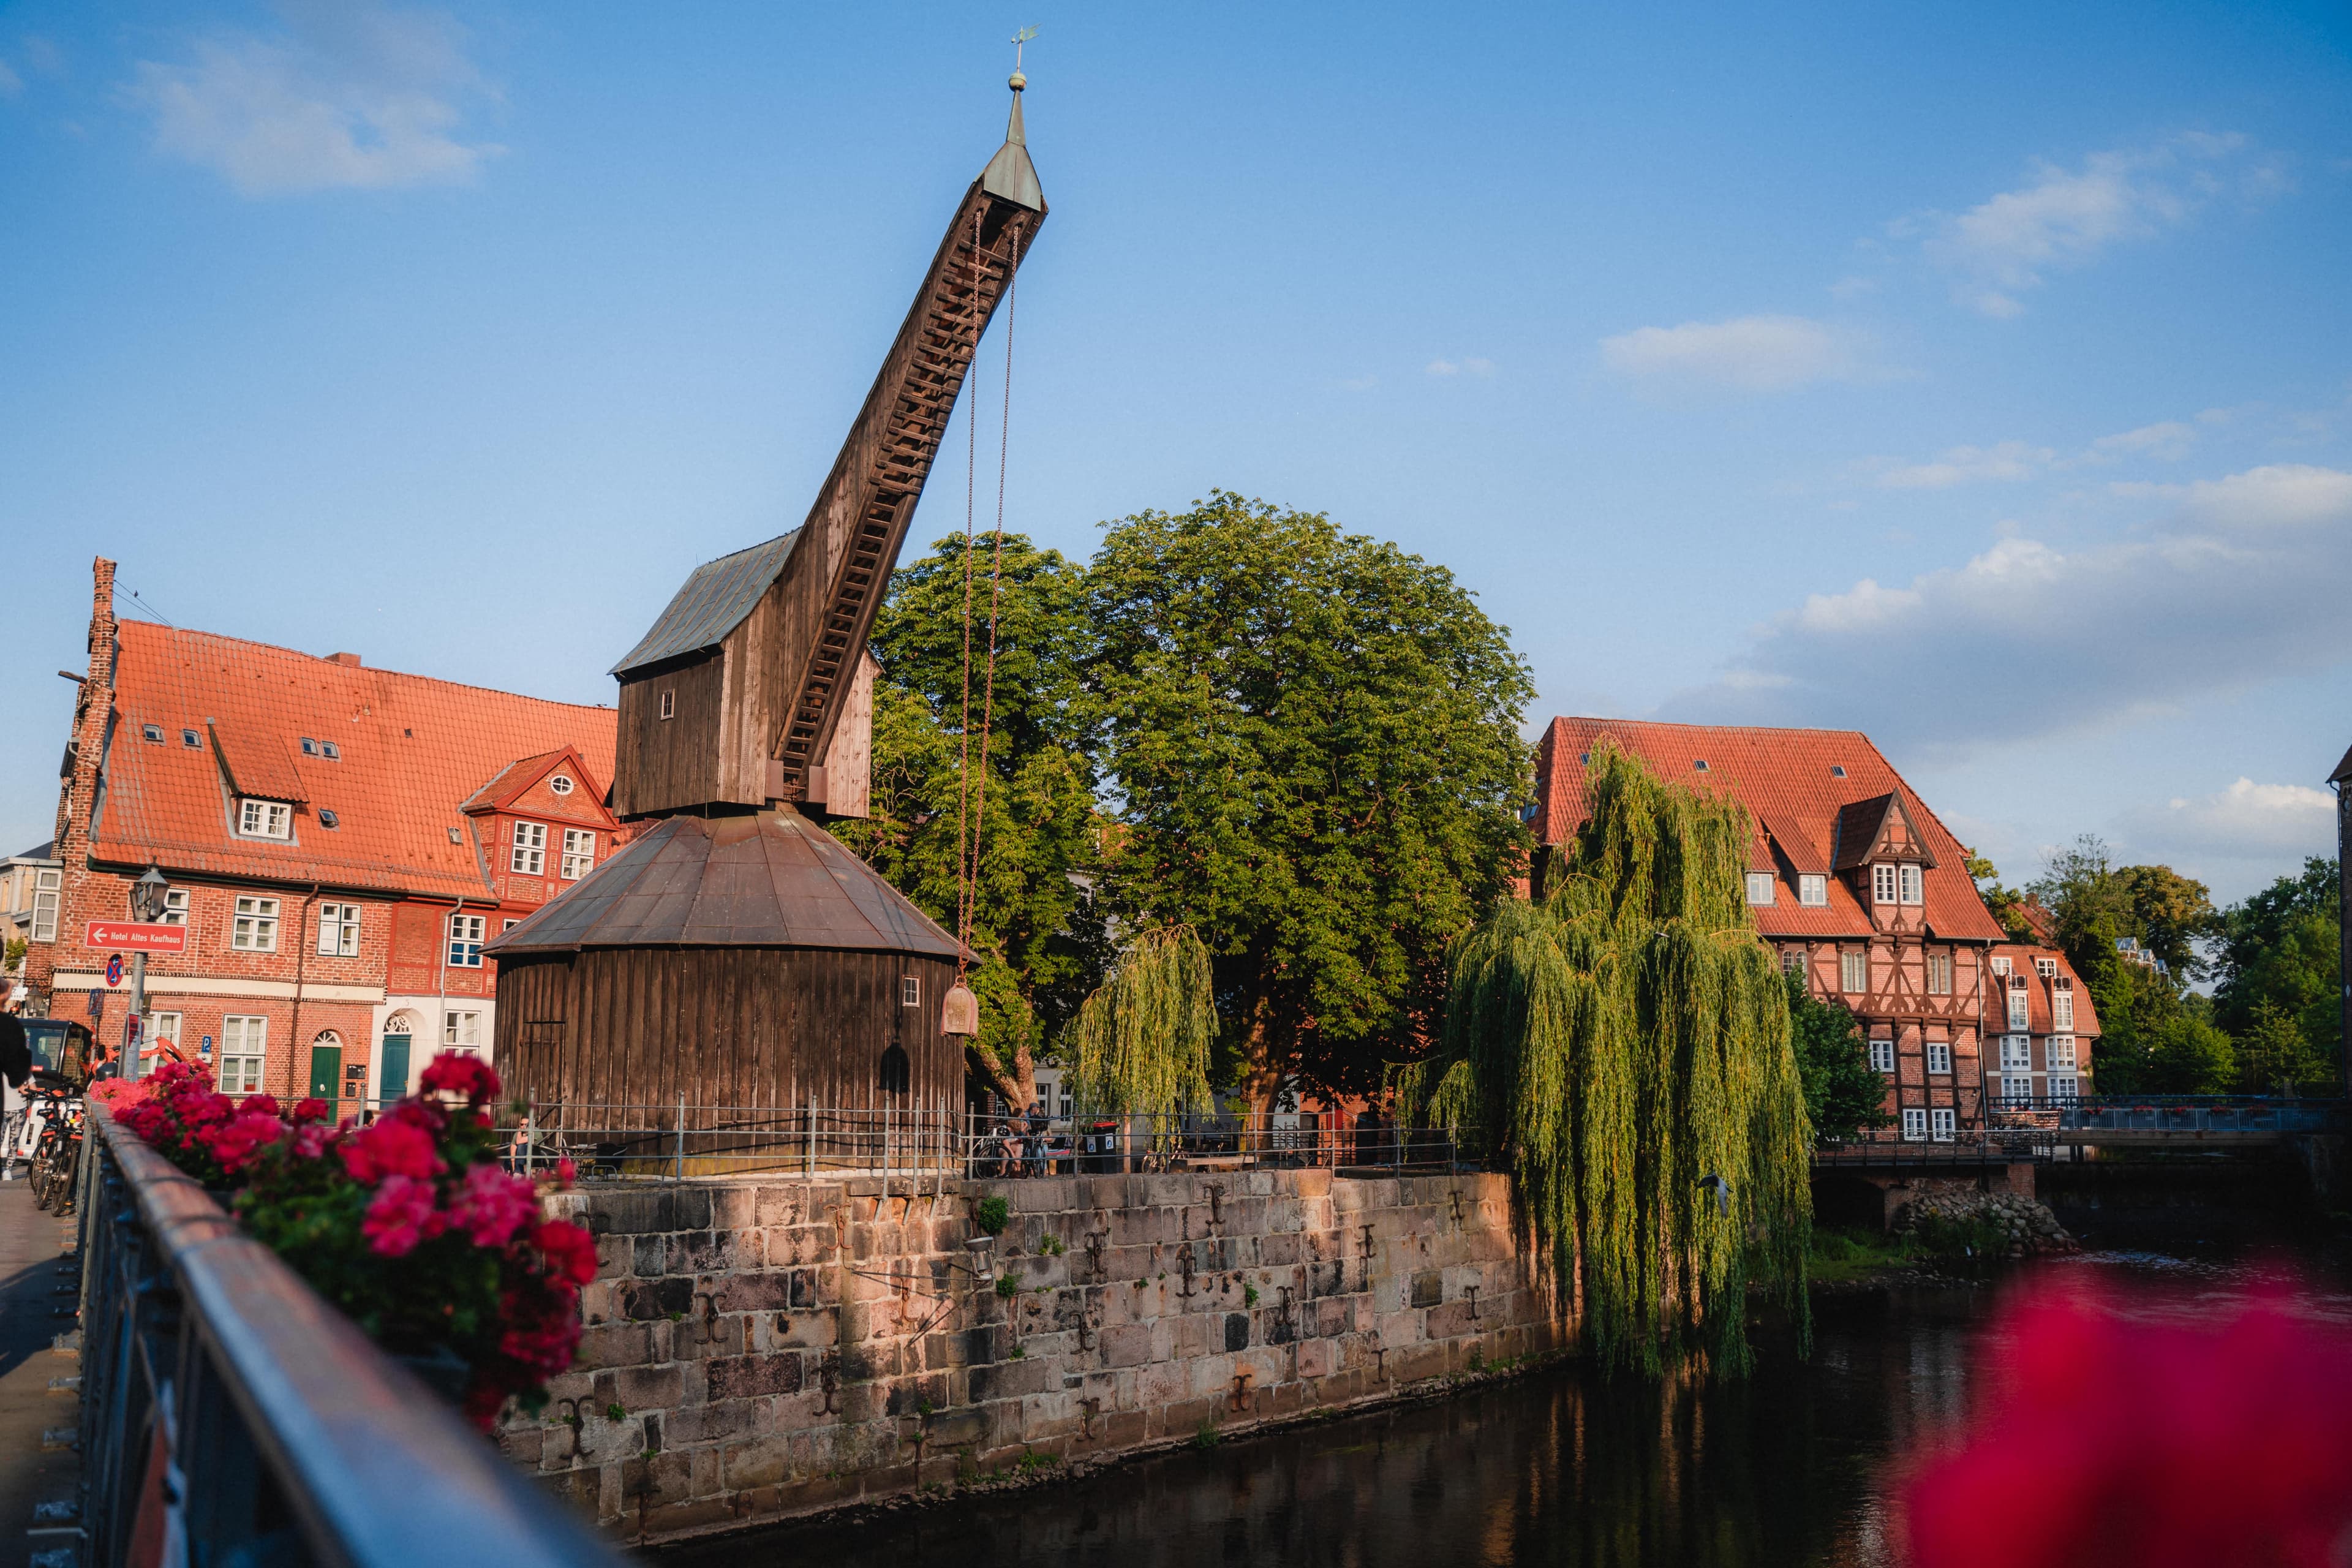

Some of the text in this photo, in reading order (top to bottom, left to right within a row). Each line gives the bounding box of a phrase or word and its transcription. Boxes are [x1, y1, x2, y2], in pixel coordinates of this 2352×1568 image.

[111, 932, 181, 944] Hotel Altes Kaufhaus
[203, 1038, 209, 1050] P
